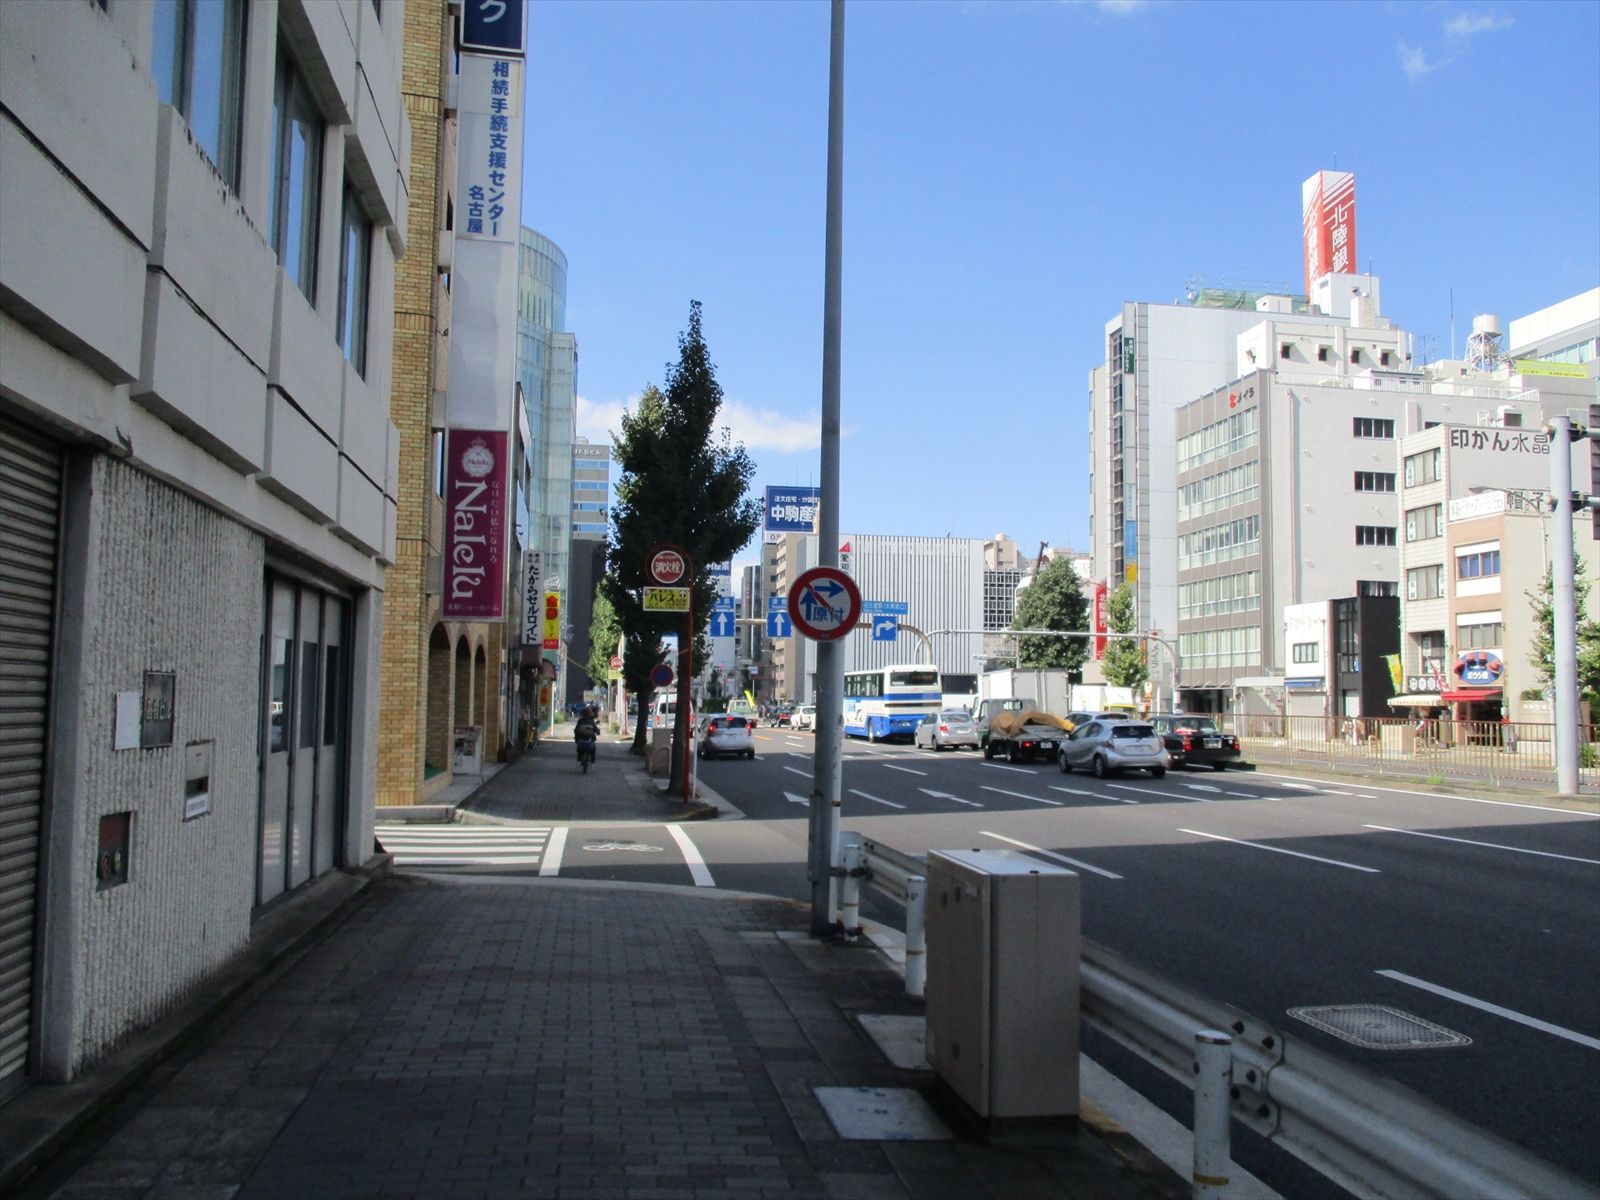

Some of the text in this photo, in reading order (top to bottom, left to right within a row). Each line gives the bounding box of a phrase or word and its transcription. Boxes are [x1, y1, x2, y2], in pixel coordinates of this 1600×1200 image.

[488, 61, 509, 236] 相続手続支援センター
[467, 185, 484, 234] 名古屋
[1329, 204, 1349, 273] 北陸銀
[1450, 428, 1550, 455] 印かん水晶
[771, 505, 817, 522] 中駒産
[452, 480, 488, 599] Nalelu
[655, 561, 681, 573] 消火栓
[526, 565, 540, 644] たからセルロイド
[814, 606, 844, 622] 原付
